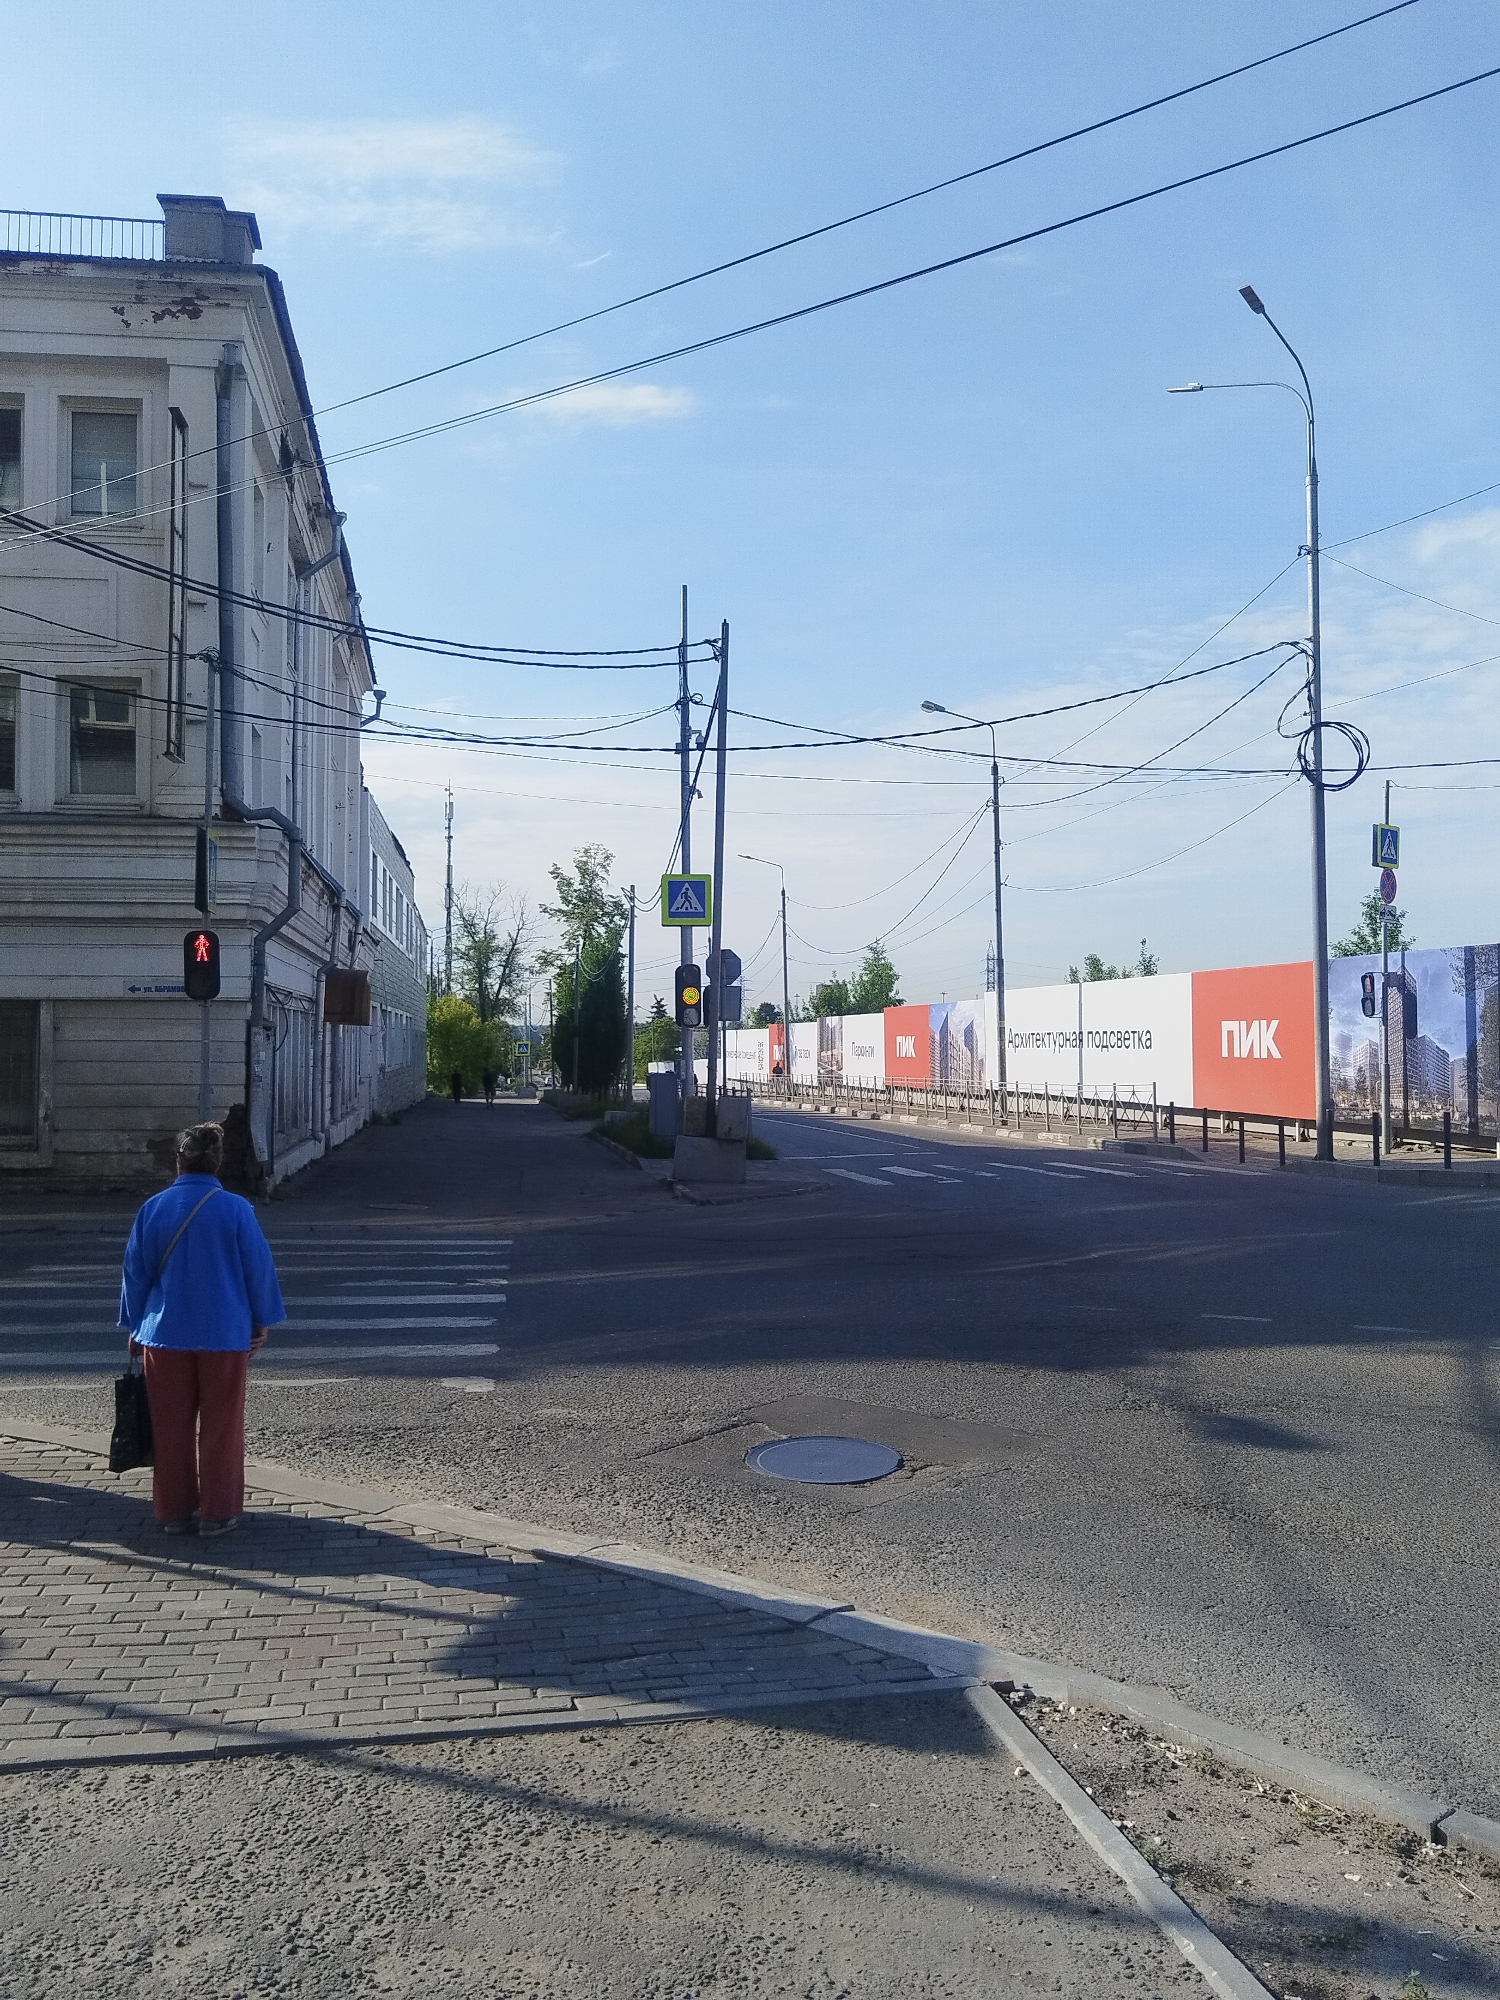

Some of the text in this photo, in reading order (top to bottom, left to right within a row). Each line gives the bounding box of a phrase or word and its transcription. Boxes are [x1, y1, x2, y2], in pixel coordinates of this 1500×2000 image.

[896, 1035, 917, 1058] ПИК
[1007, 1027, 1153, 1054] Архитектурная подсветка
[1221, 1019, 1282, 1059] ПИК
